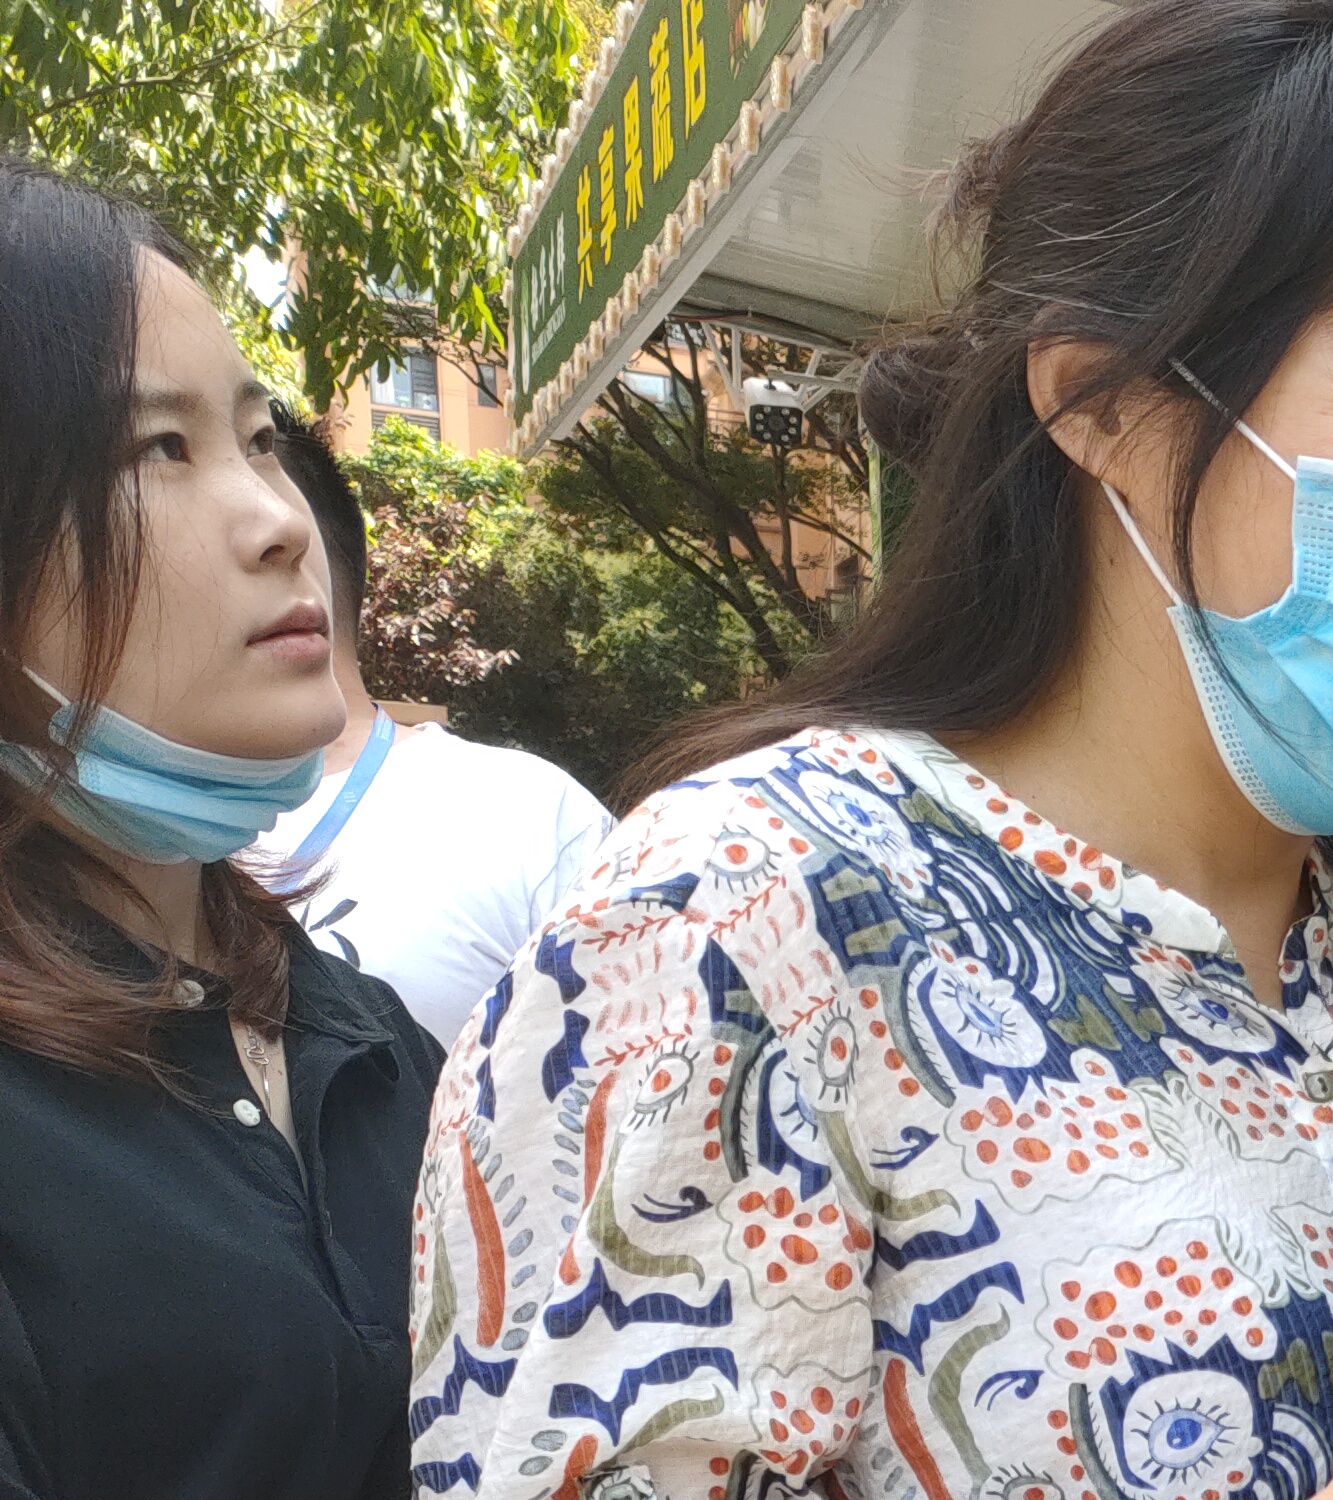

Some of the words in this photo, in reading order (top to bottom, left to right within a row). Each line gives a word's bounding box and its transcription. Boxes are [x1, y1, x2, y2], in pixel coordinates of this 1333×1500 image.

[577, 0, 706, 303] 共享果蔬店
